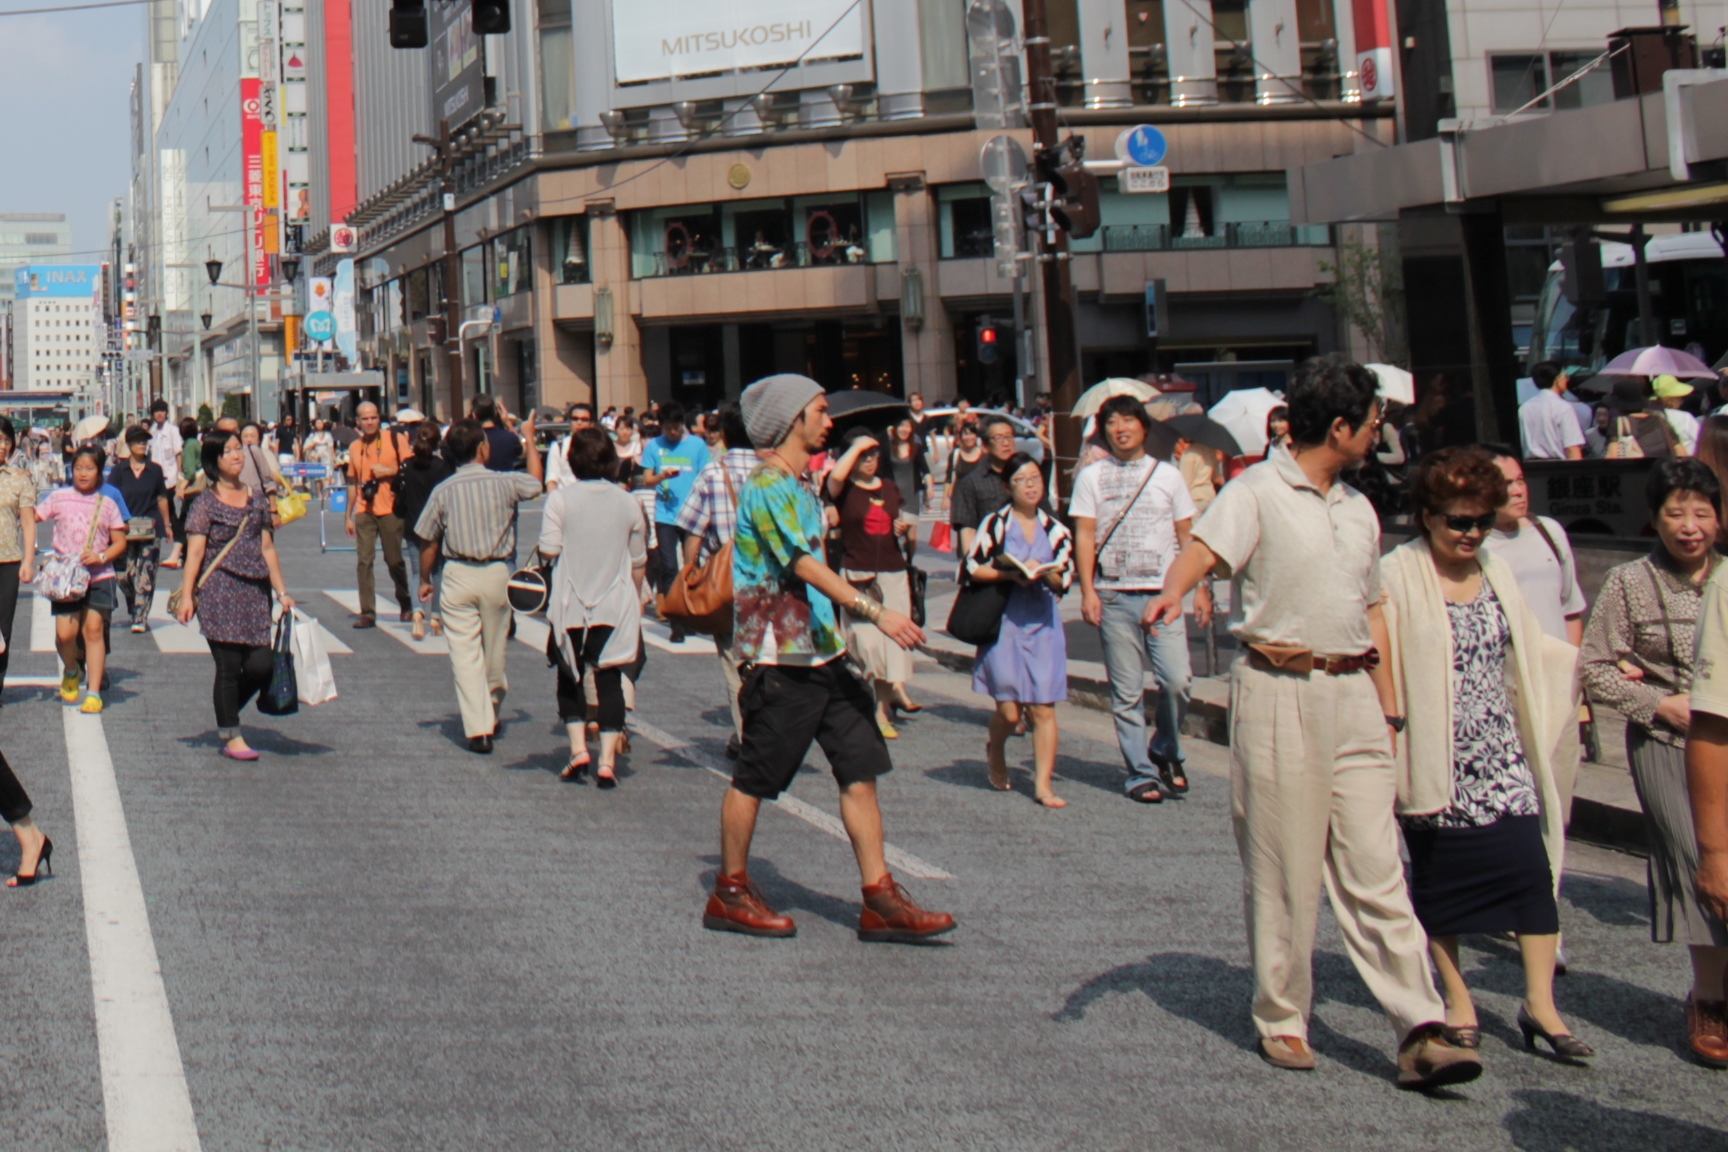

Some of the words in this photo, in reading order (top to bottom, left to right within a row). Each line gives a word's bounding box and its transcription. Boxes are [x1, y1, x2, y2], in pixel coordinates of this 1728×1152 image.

[661, 20, 812, 57] MITSUKOSHI
[47, 271, 87, 284] INAX
[1548, 475, 1622, 500] 銀座駅
[1550, 501, 1591, 516] Ginza
[1596, 501, 1624, 515] Sta.
